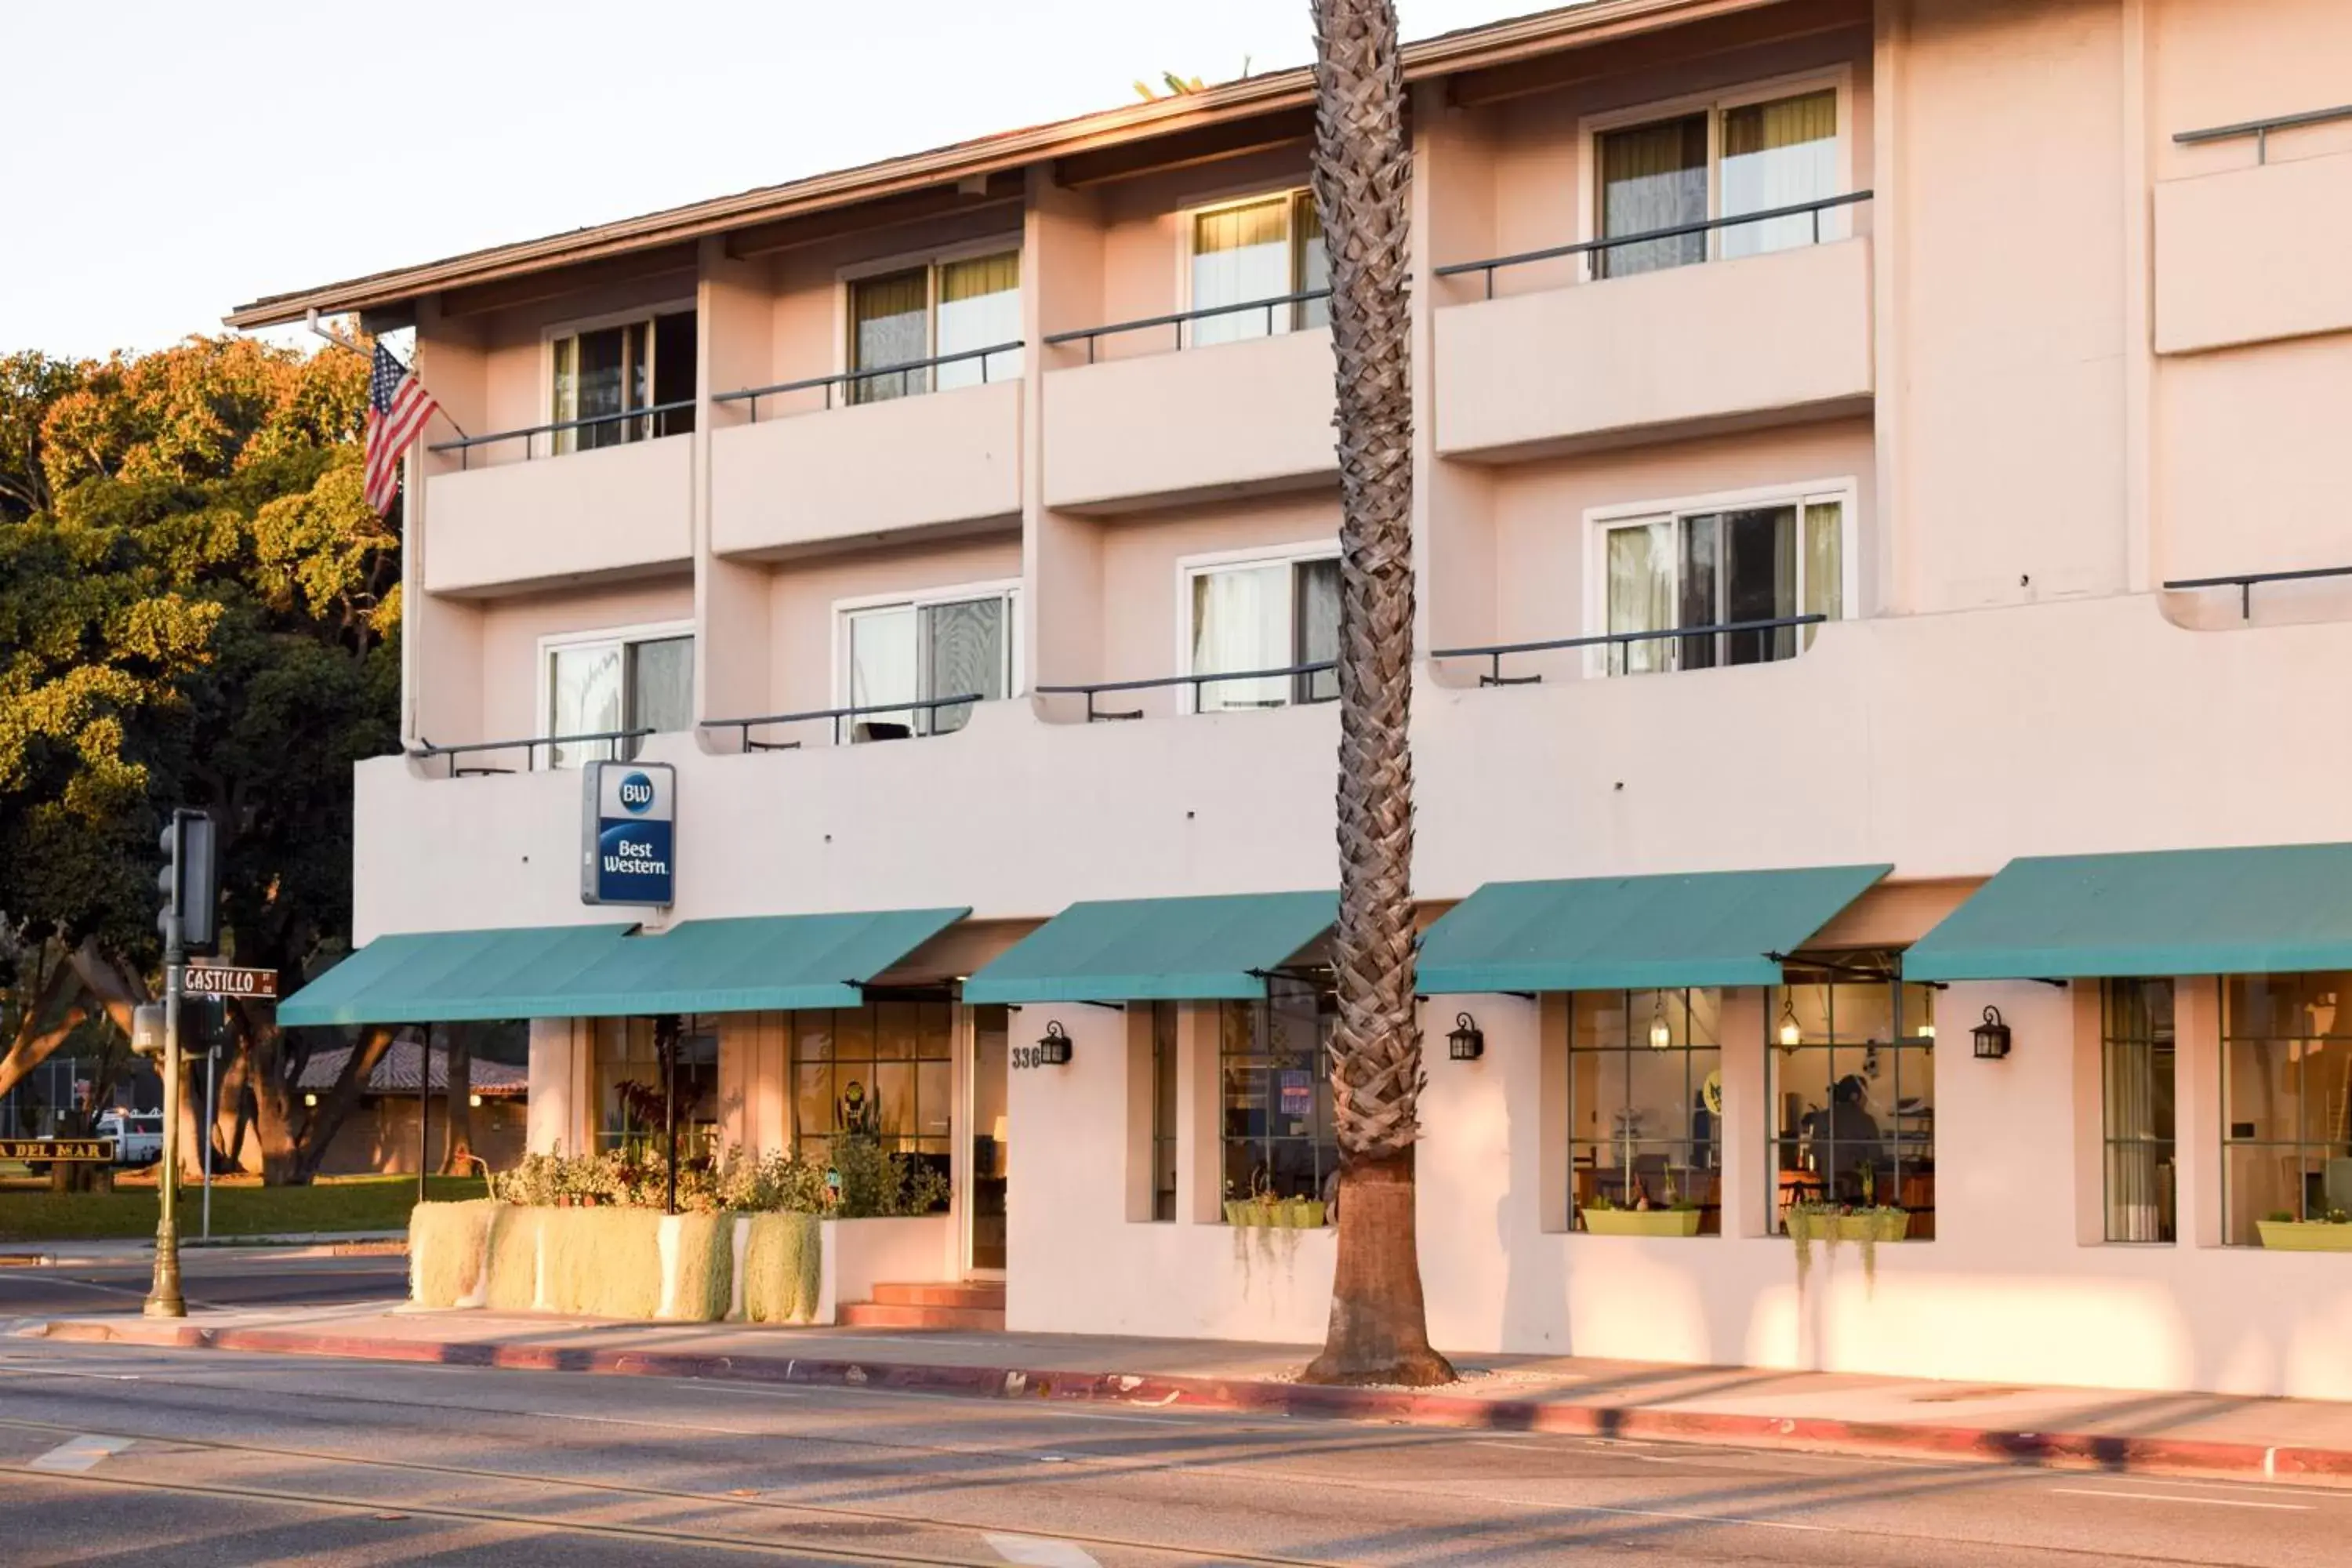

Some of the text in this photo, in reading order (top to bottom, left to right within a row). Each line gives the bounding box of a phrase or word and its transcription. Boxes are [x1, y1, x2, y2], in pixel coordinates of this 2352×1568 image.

[623, 784, 651, 803] BW
[619, 840, 653, 858] Best
[604, 855, 666, 874] Western
[185, 970, 253, 992] CASTILLO
[1012, 1047, 1040, 1069] 336
[16, 1144, 49, 1157] DEL
[56, 1144, 101, 1158] MAR
